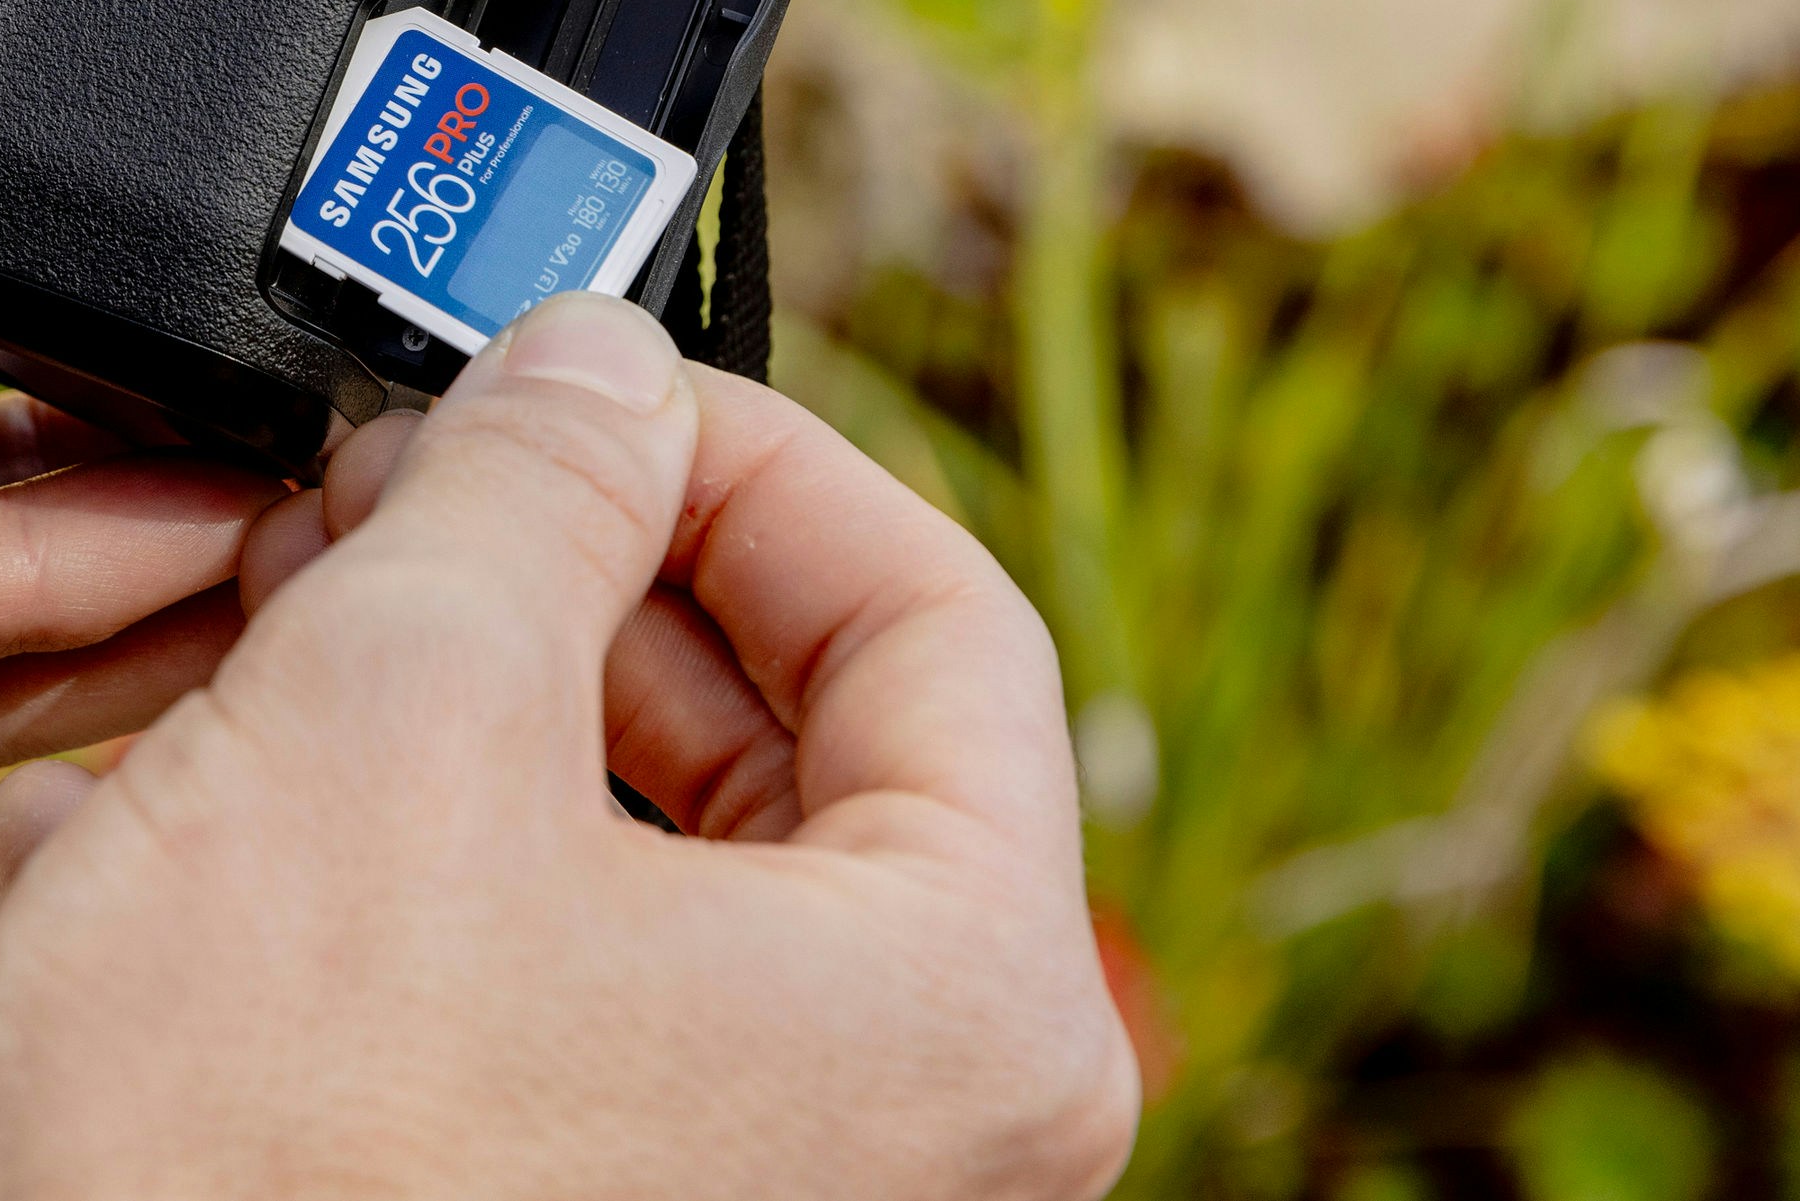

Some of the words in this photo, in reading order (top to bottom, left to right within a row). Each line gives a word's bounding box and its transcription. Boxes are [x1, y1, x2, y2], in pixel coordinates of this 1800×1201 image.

[319, 53, 442, 228] SAMSUNG
[423, 82, 490, 164] PRO
[456, 131, 496, 177] Plus
[479, 166, 494, 185] For
[489, 105, 534, 169] Professionals
[371, 161, 476, 278] 256
[549, 233, 582, 266] V30
[572, 195, 605, 230] 180
[594, 160, 627, 194] 130
